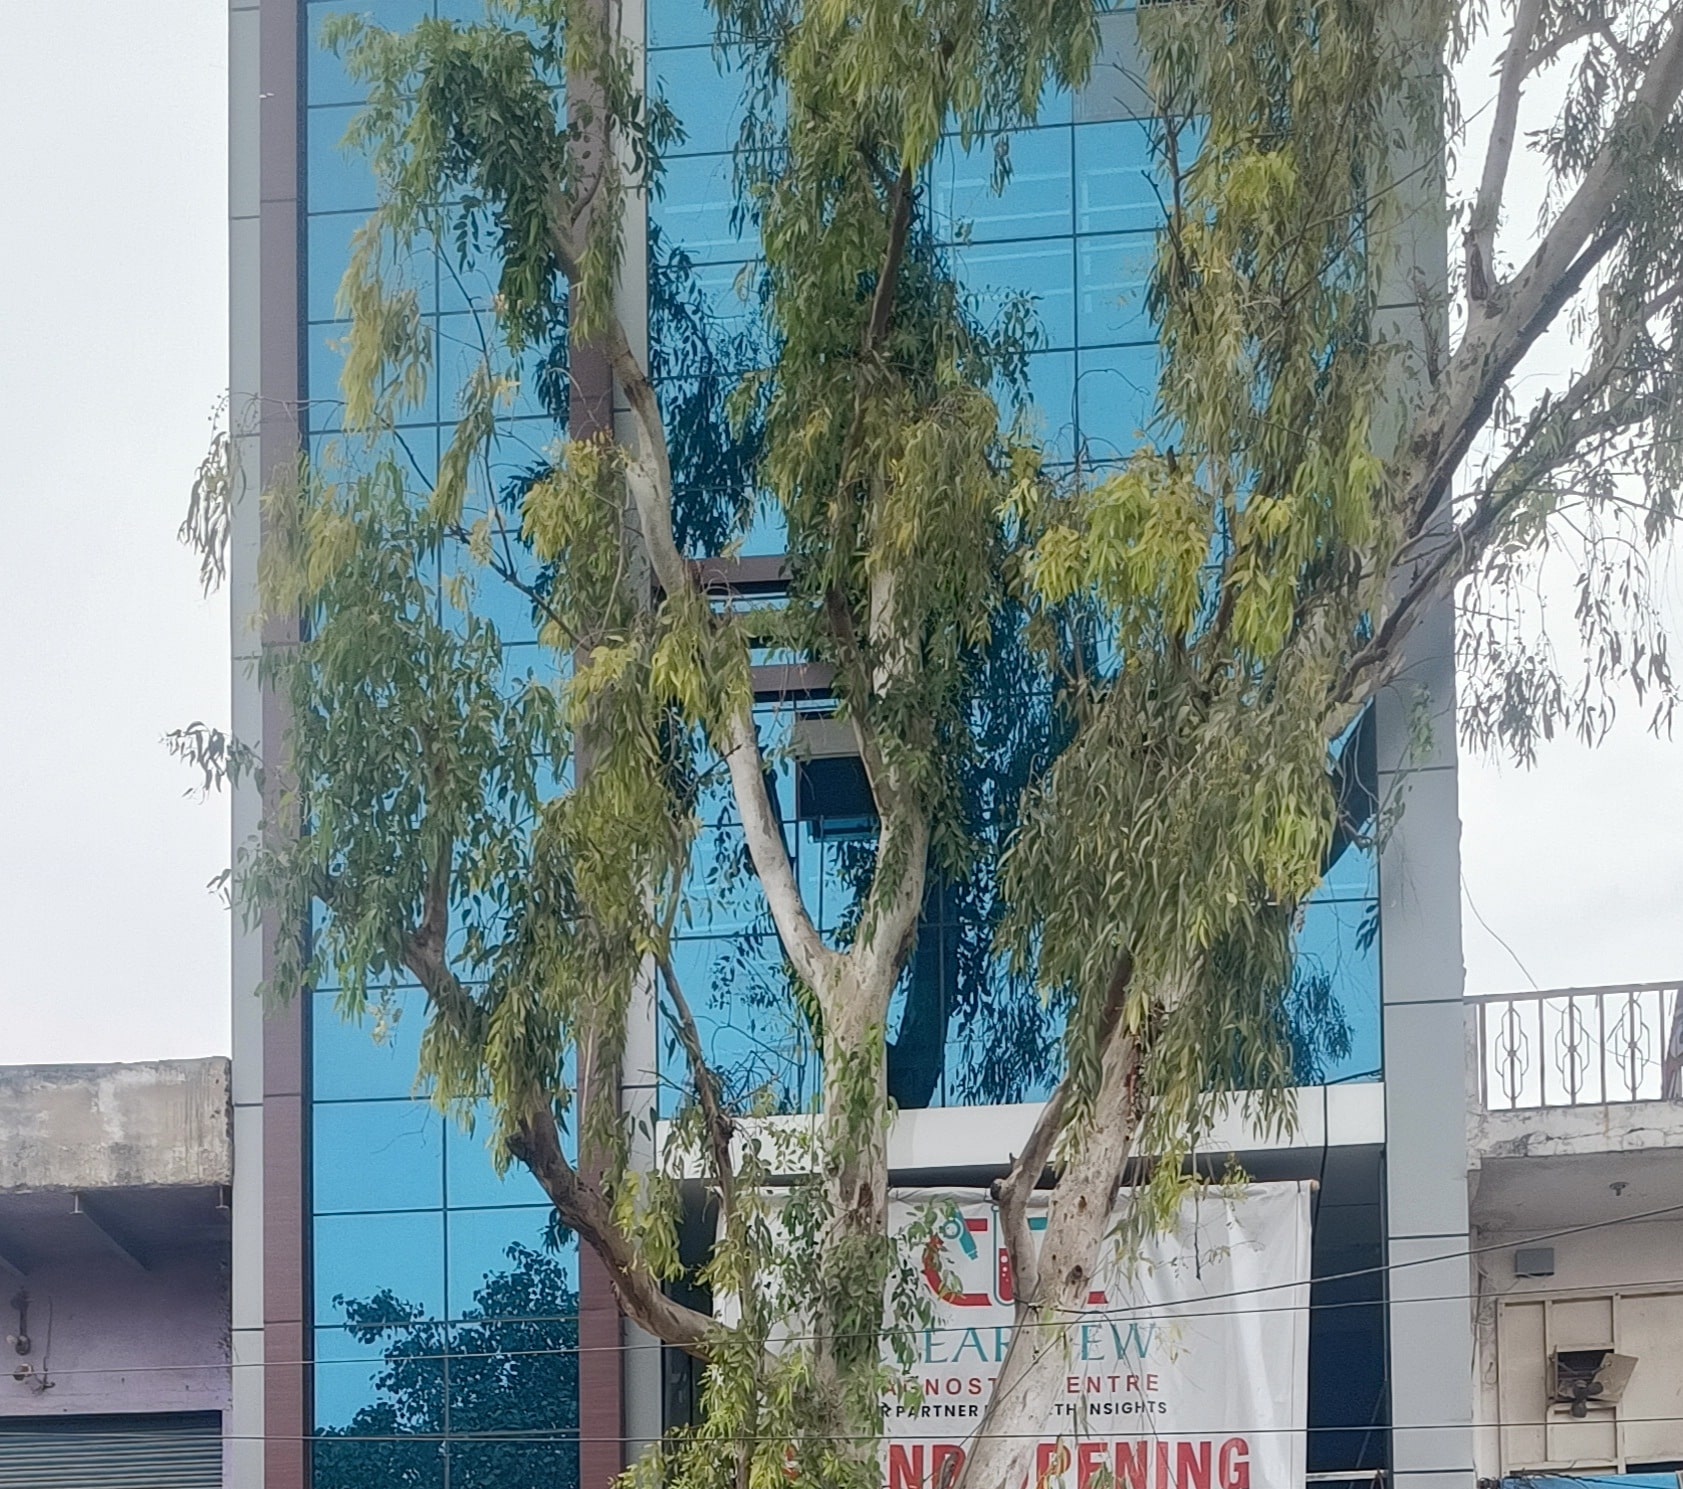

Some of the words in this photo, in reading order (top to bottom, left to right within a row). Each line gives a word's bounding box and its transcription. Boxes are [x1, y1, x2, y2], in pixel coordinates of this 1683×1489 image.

[1066, 1373, 1159, 1394] ENTRE
[896, 1403, 978, 1418] PARTNER
[1089, 1401, 1168, 1416] NSIGHTS
